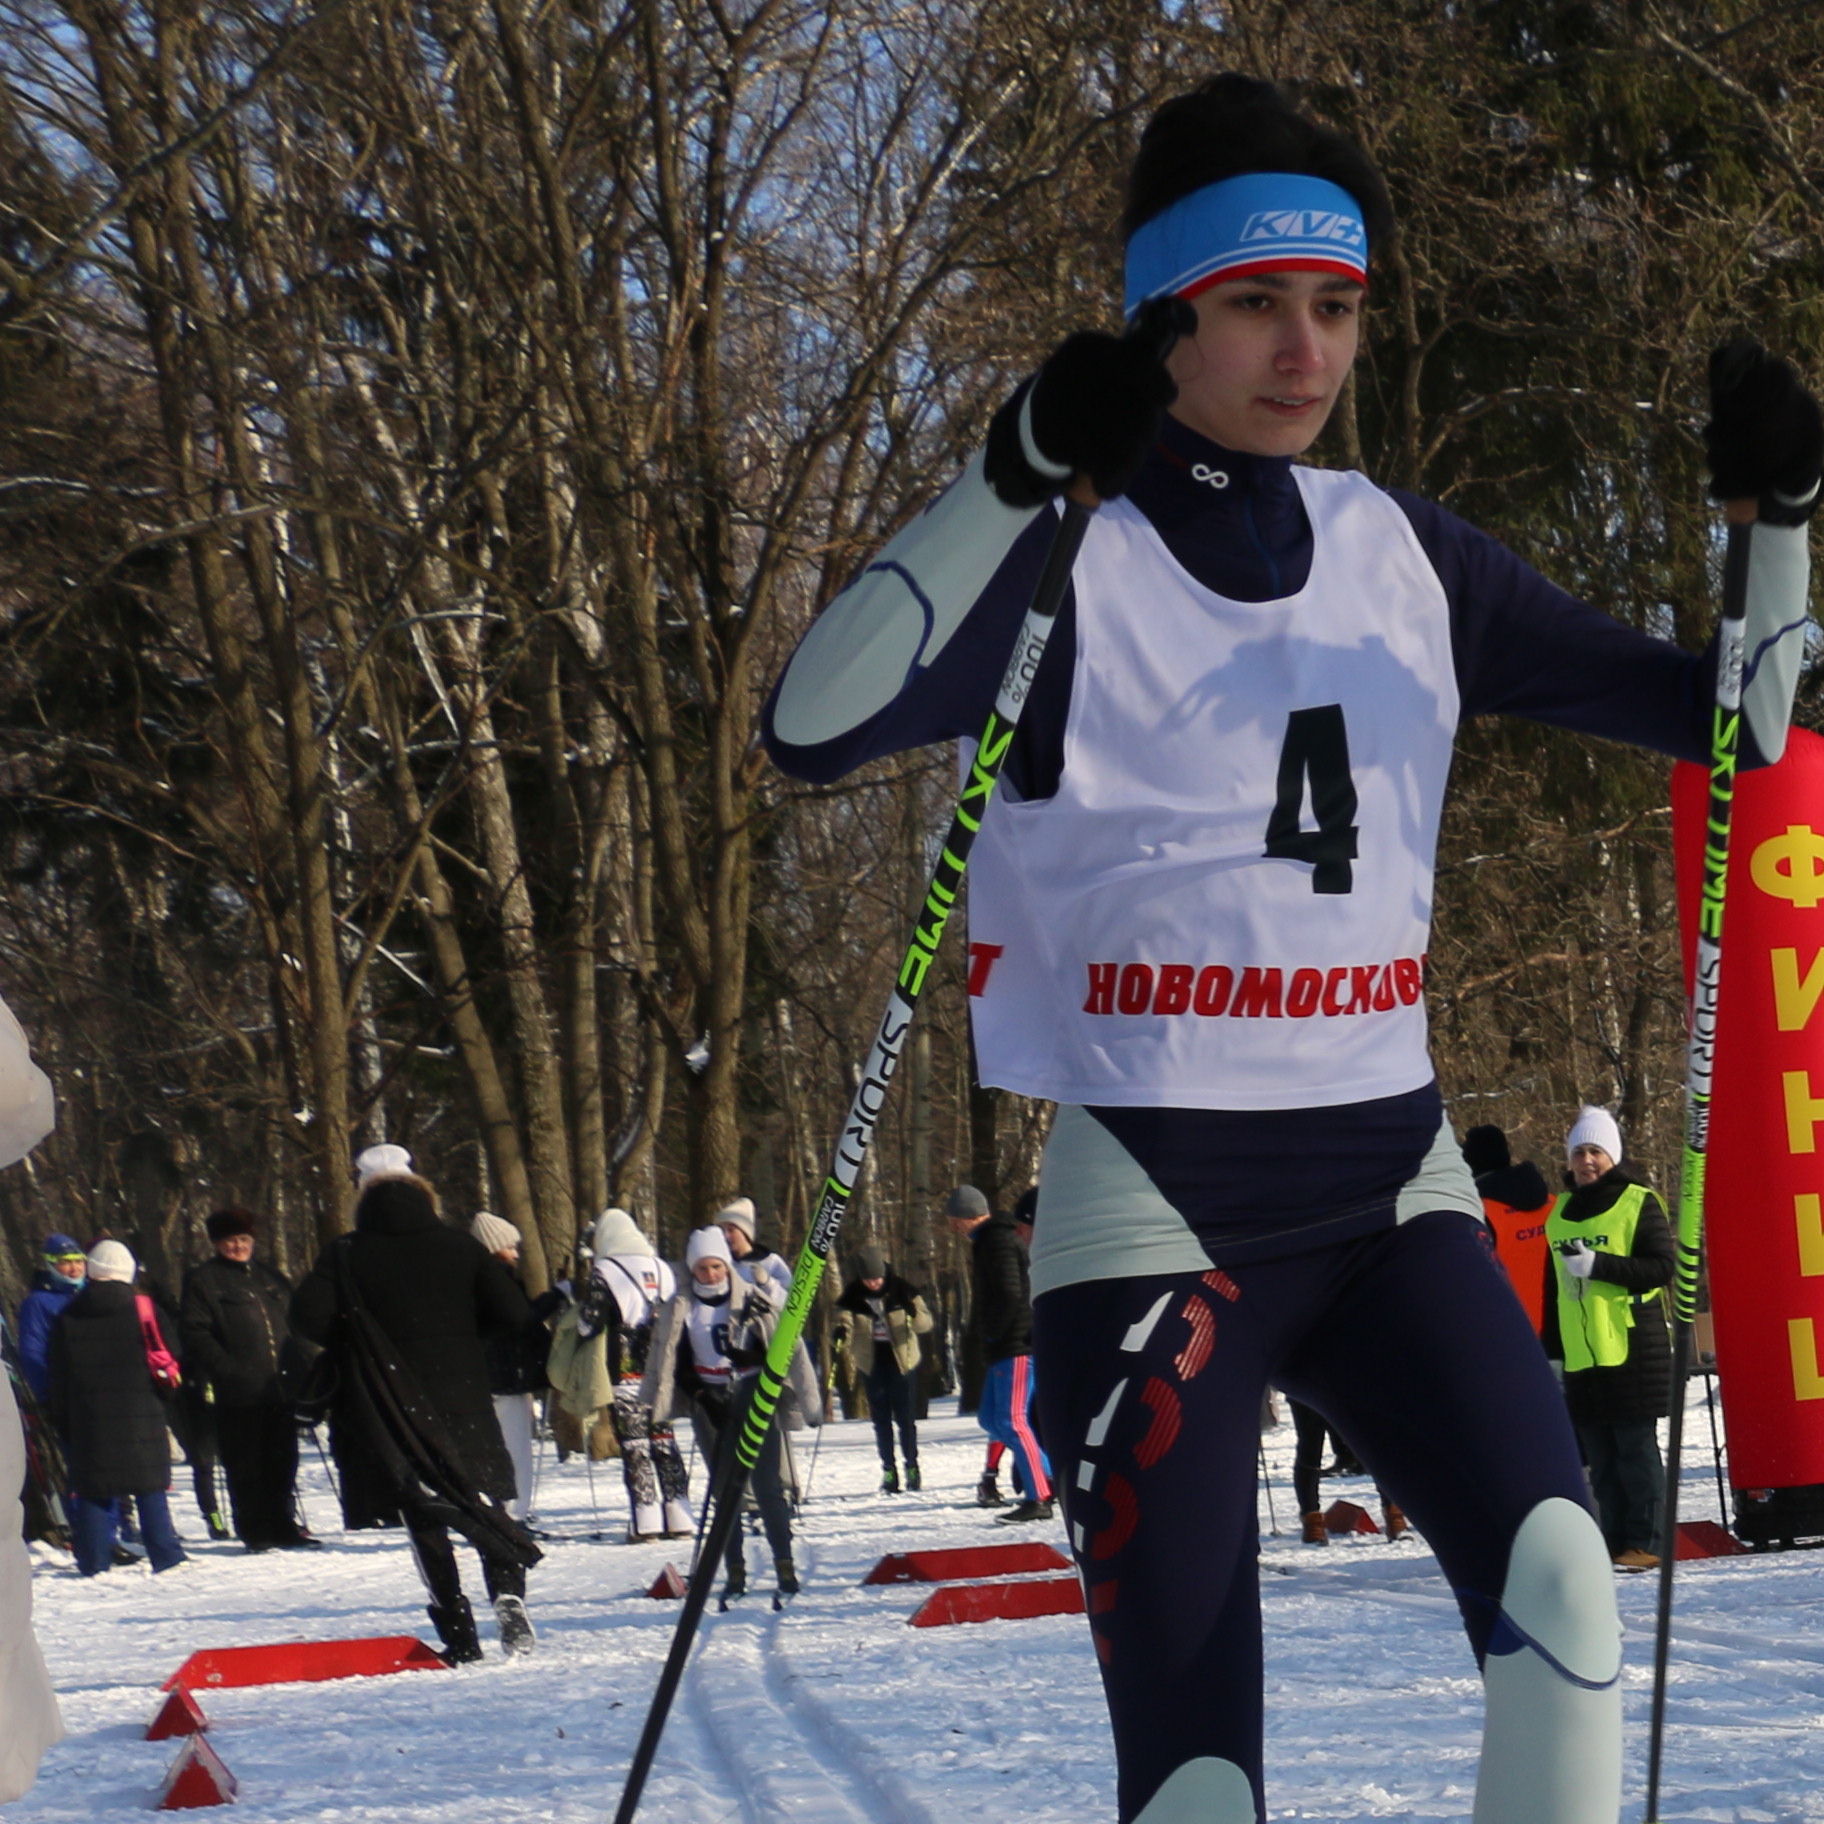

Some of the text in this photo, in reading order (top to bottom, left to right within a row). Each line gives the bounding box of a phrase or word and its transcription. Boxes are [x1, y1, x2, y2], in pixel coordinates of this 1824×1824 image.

[1262, 702, 1360, 895] 4
[1082, 953, 1428, 1019] НОВОМОСКОВ
[821, 1201, 847, 1253] 100%
[786, 1251, 815, 1318] DESIGN
